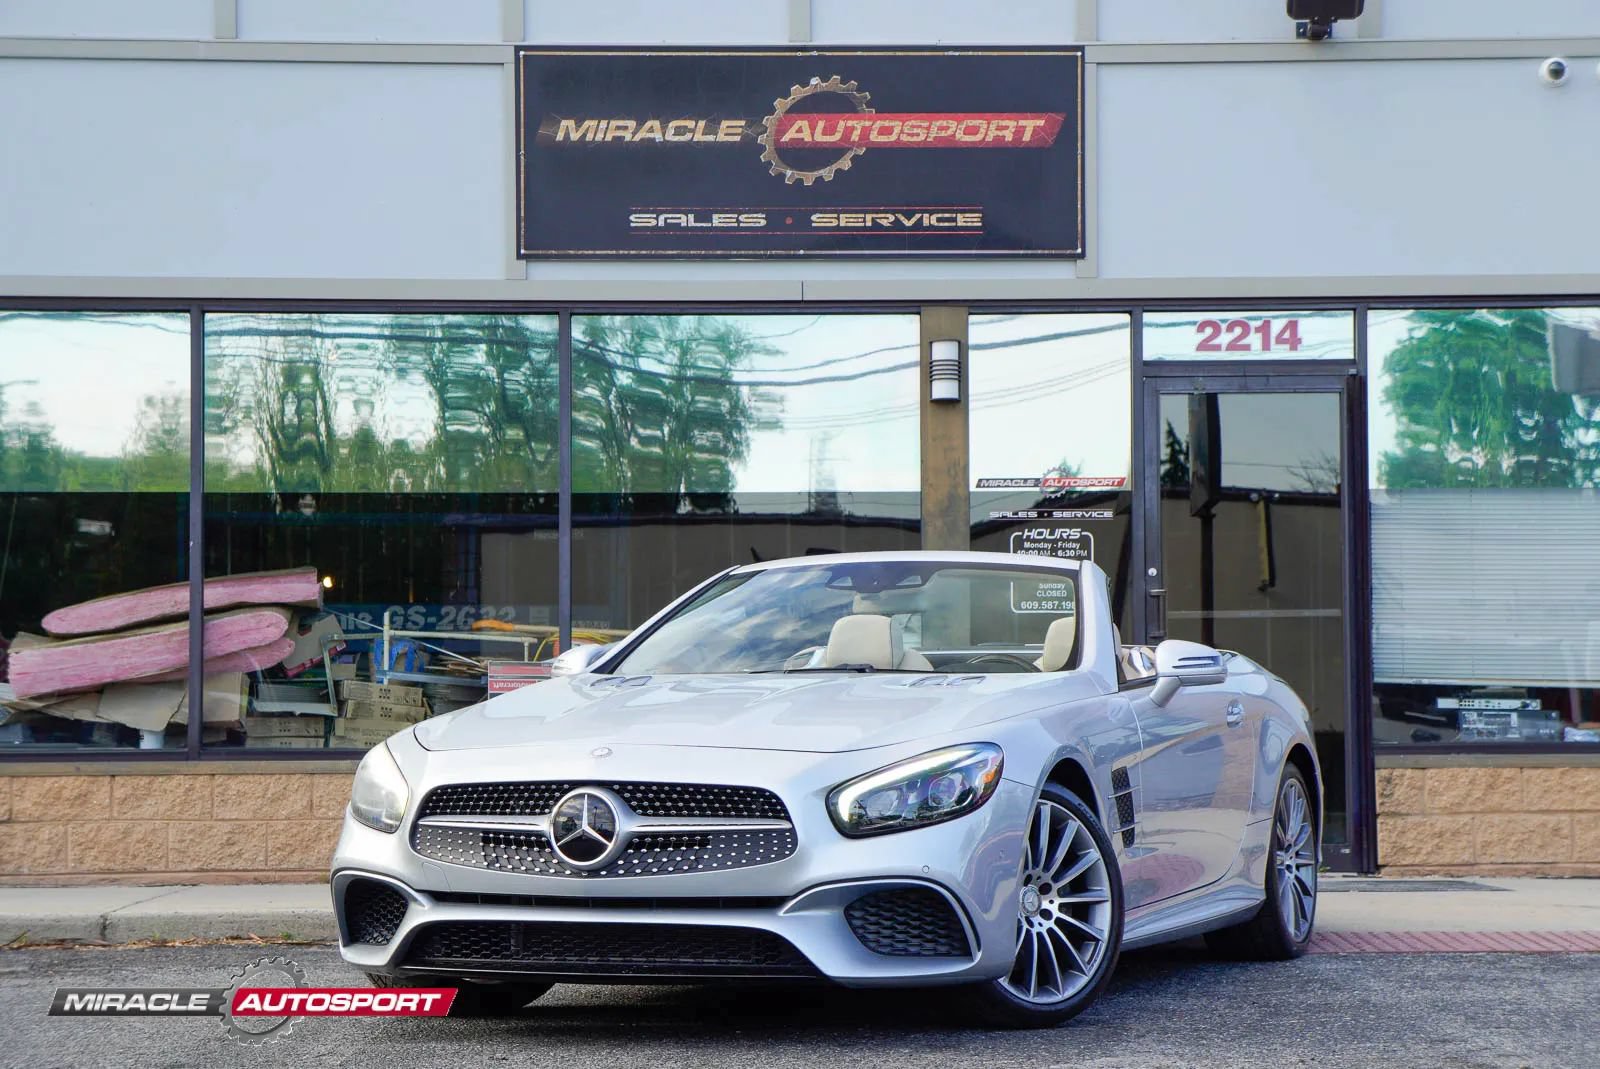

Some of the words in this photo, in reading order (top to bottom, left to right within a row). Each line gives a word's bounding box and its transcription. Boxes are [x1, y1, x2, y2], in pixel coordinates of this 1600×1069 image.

[555, 119, 747, 142] MIRACLE
[780, 119, 1046, 143] AUTOSPORT
[629, 212, 767, 228] SALES
[810, 212, 983, 228] SERVICE
[1196, 320, 1302, 351] 2214
[980, 479, 1034, 487] MIRACLE
[1045, 478, 1120, 487] AUTOSPORT
[1023, 528, 1081, 540] HOURS
[1023, 542, 1052, 550] Monday
[1057, 541, 1081, 549] Friday
